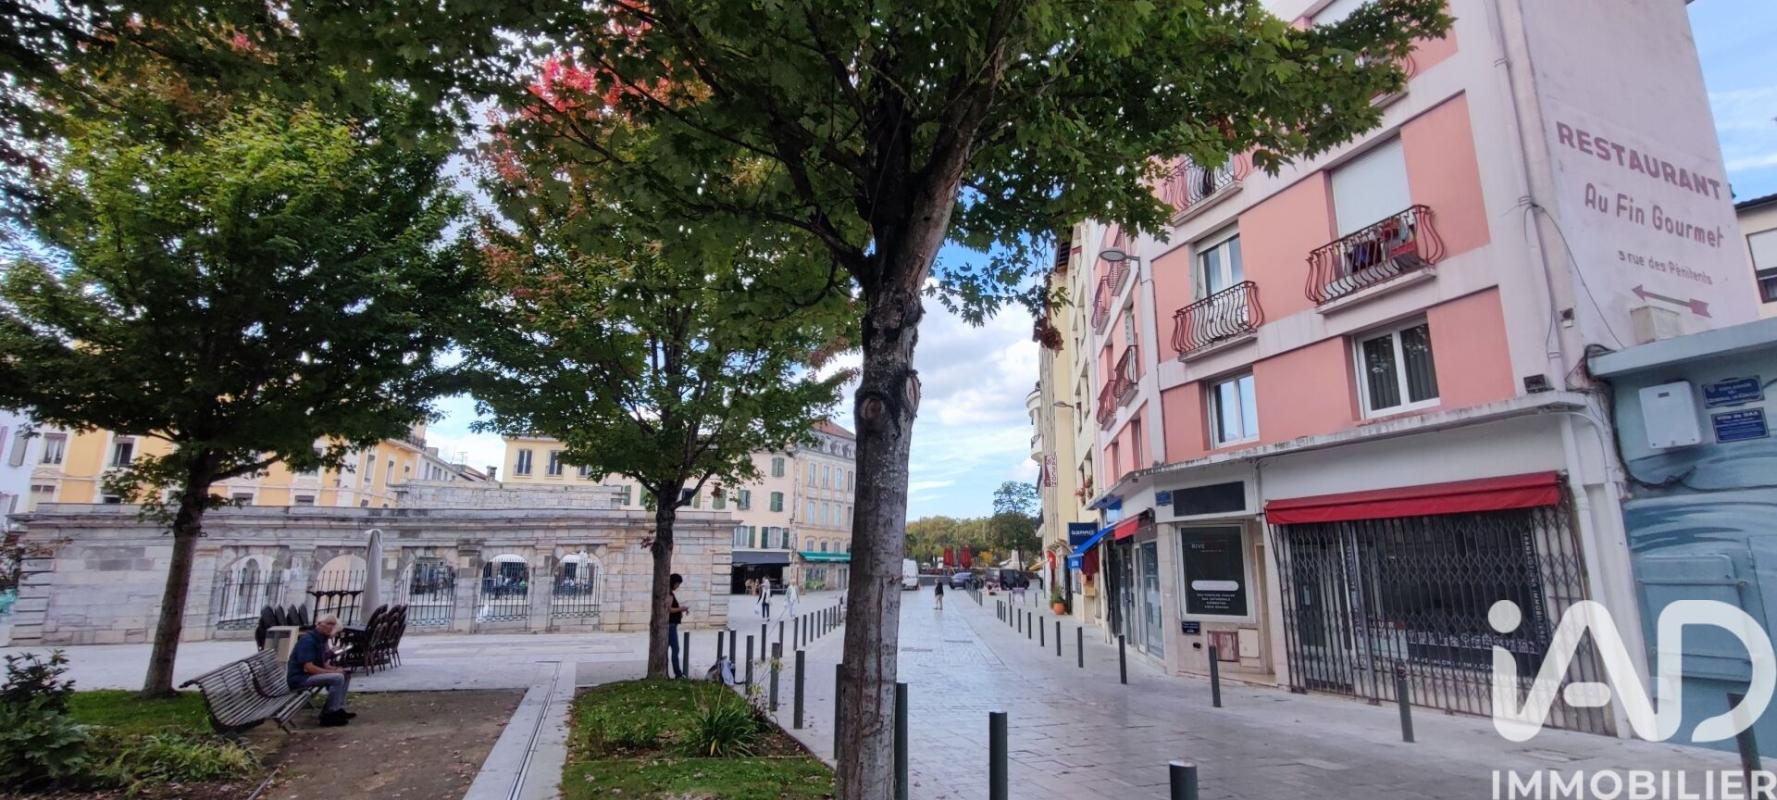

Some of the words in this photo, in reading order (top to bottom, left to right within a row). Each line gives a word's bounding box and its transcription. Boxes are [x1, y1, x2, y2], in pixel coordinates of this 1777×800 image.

[1556, 121, 1720, 200] RESTAURANT
[1585, 182, 1608, 214] Au
[1616, 193, 1645, 225] Fin
[1652, 205, 1724, 248] Gourmet
[1627, 253, 1645, 266] rue
[1648, 255, 1666, 272] des
